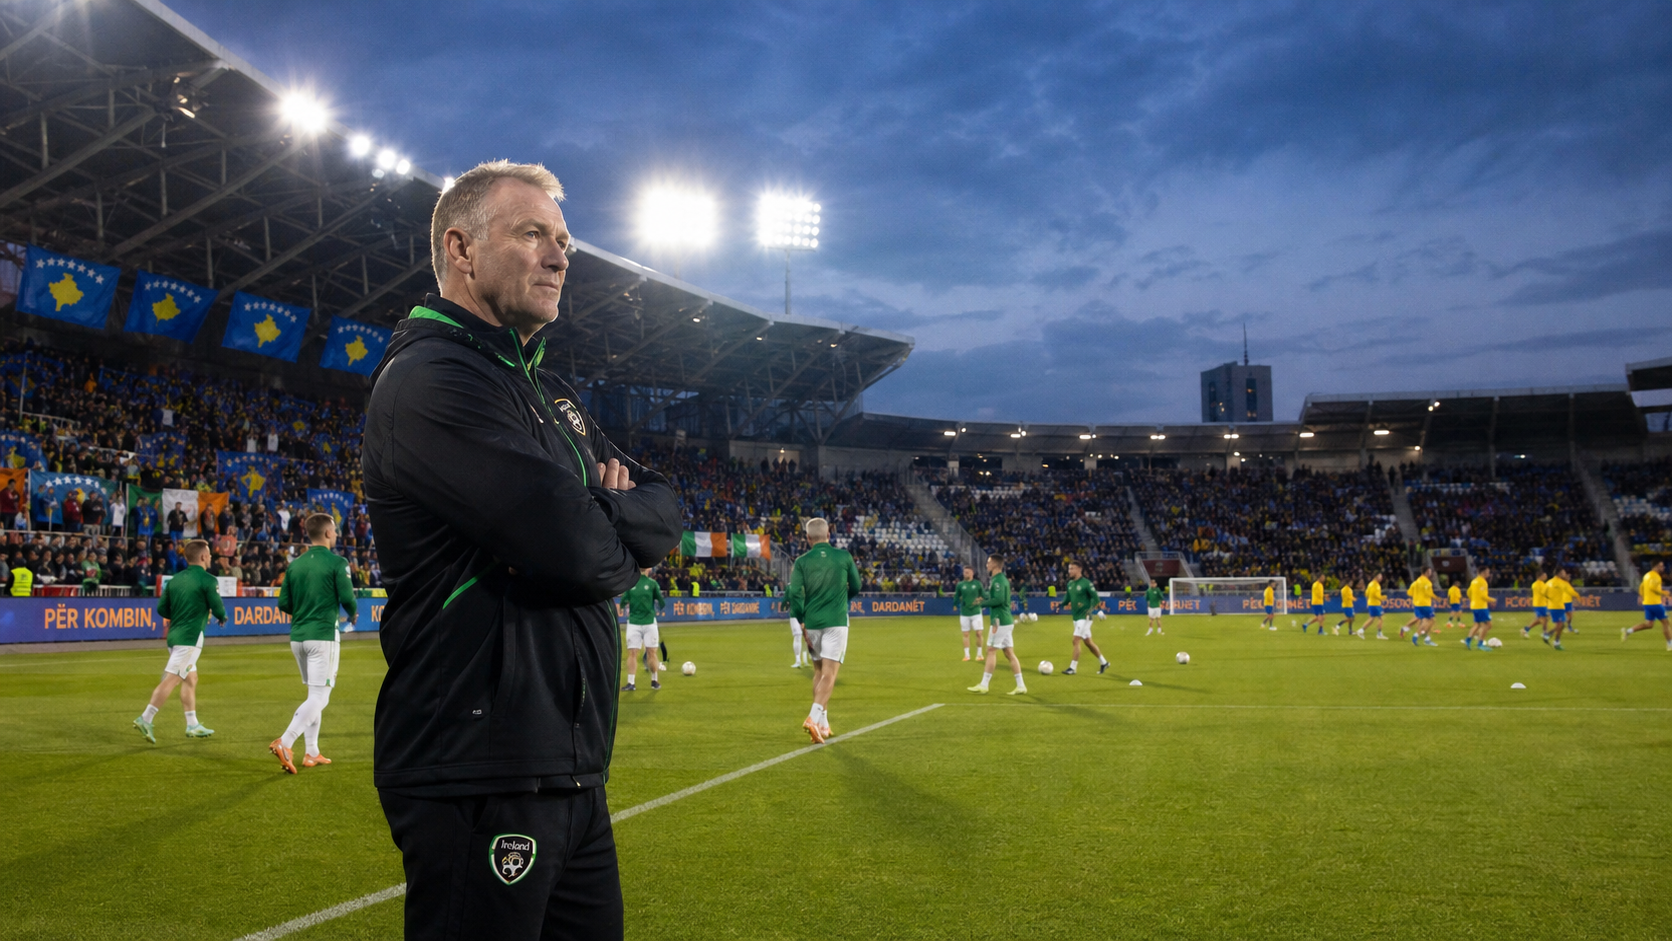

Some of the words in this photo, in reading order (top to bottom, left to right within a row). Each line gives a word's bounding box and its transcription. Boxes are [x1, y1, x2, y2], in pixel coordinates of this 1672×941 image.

[44, 603, 78, 629] PËR
[84, 607, 157, 631] KOMBIN,
[501, 840, 530, 851] Ireland
